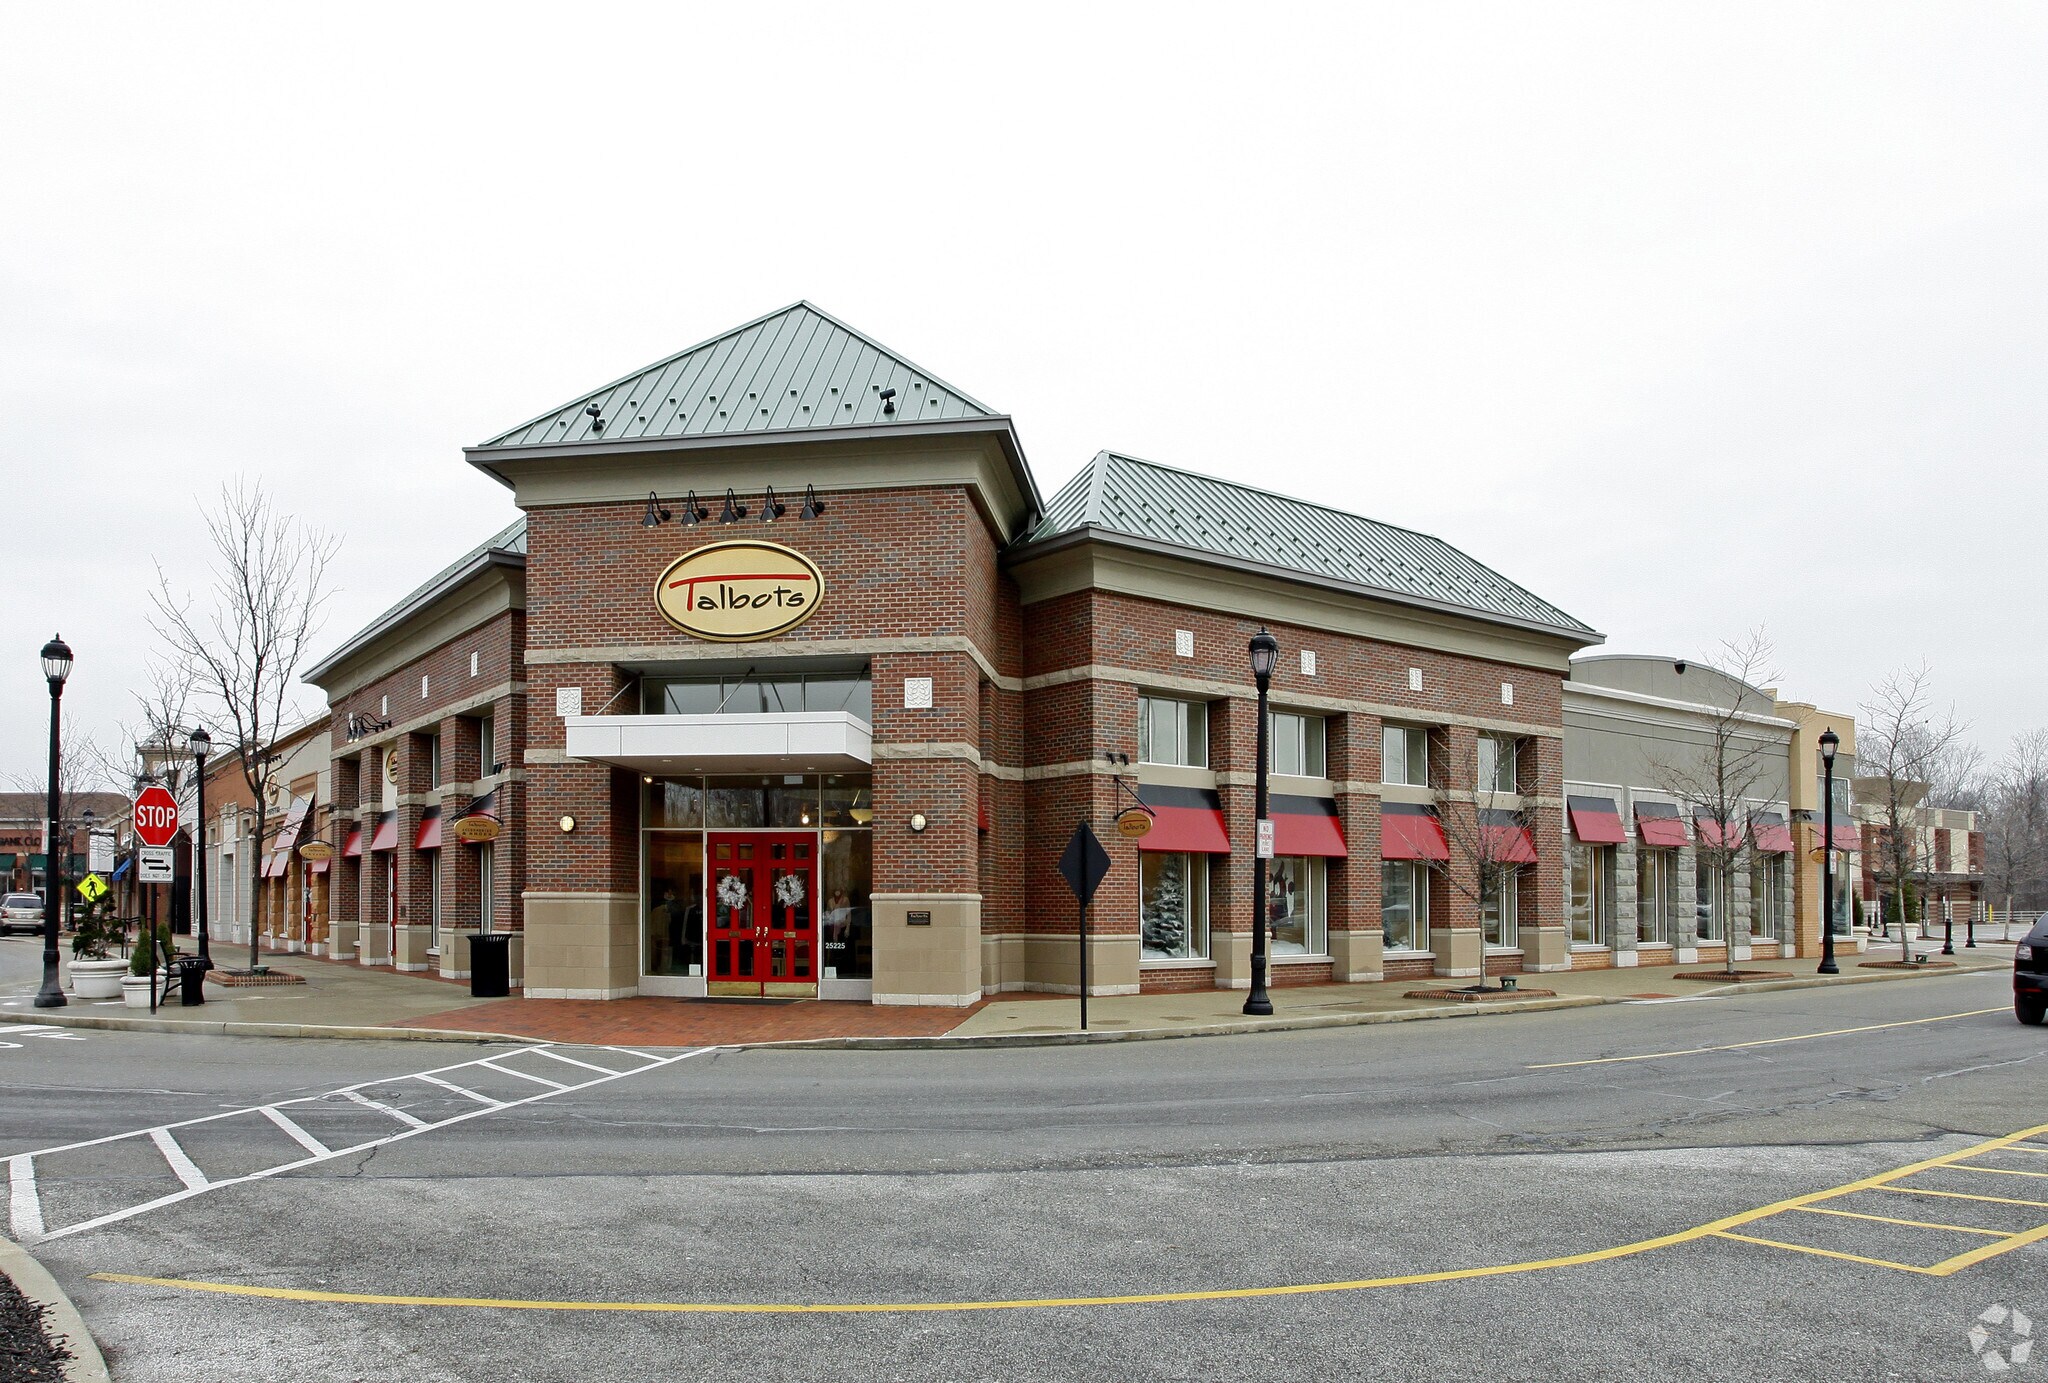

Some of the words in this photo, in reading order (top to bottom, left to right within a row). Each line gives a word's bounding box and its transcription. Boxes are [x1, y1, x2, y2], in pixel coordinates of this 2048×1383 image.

[668, 573, 811, 611] Talbots
[137, 805, 176, 828] STOP
[1121, 819, 1147, 830] Talbots
